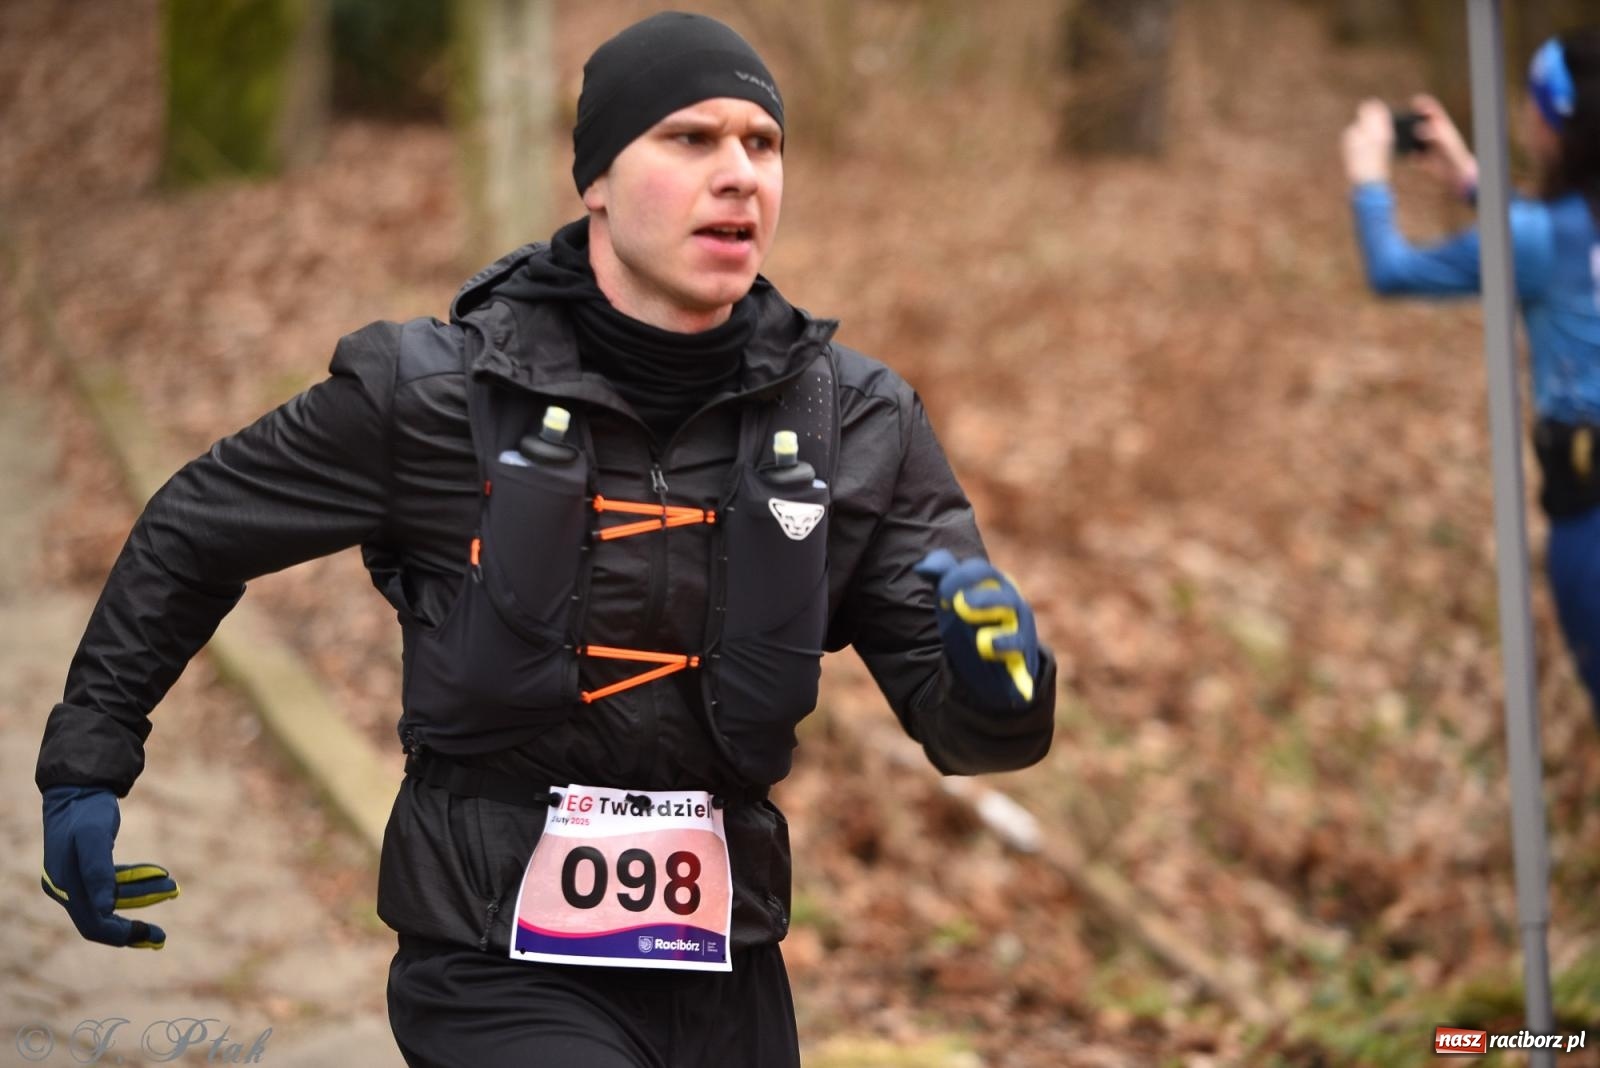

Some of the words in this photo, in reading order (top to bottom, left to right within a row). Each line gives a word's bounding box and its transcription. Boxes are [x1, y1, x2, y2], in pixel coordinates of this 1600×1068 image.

[560, 794, 593, 813] IEG
[570, 817, 590, 826] 2025
[561, 845, 701, 916] 098
[654, 938, 700, 952] Racibórz
